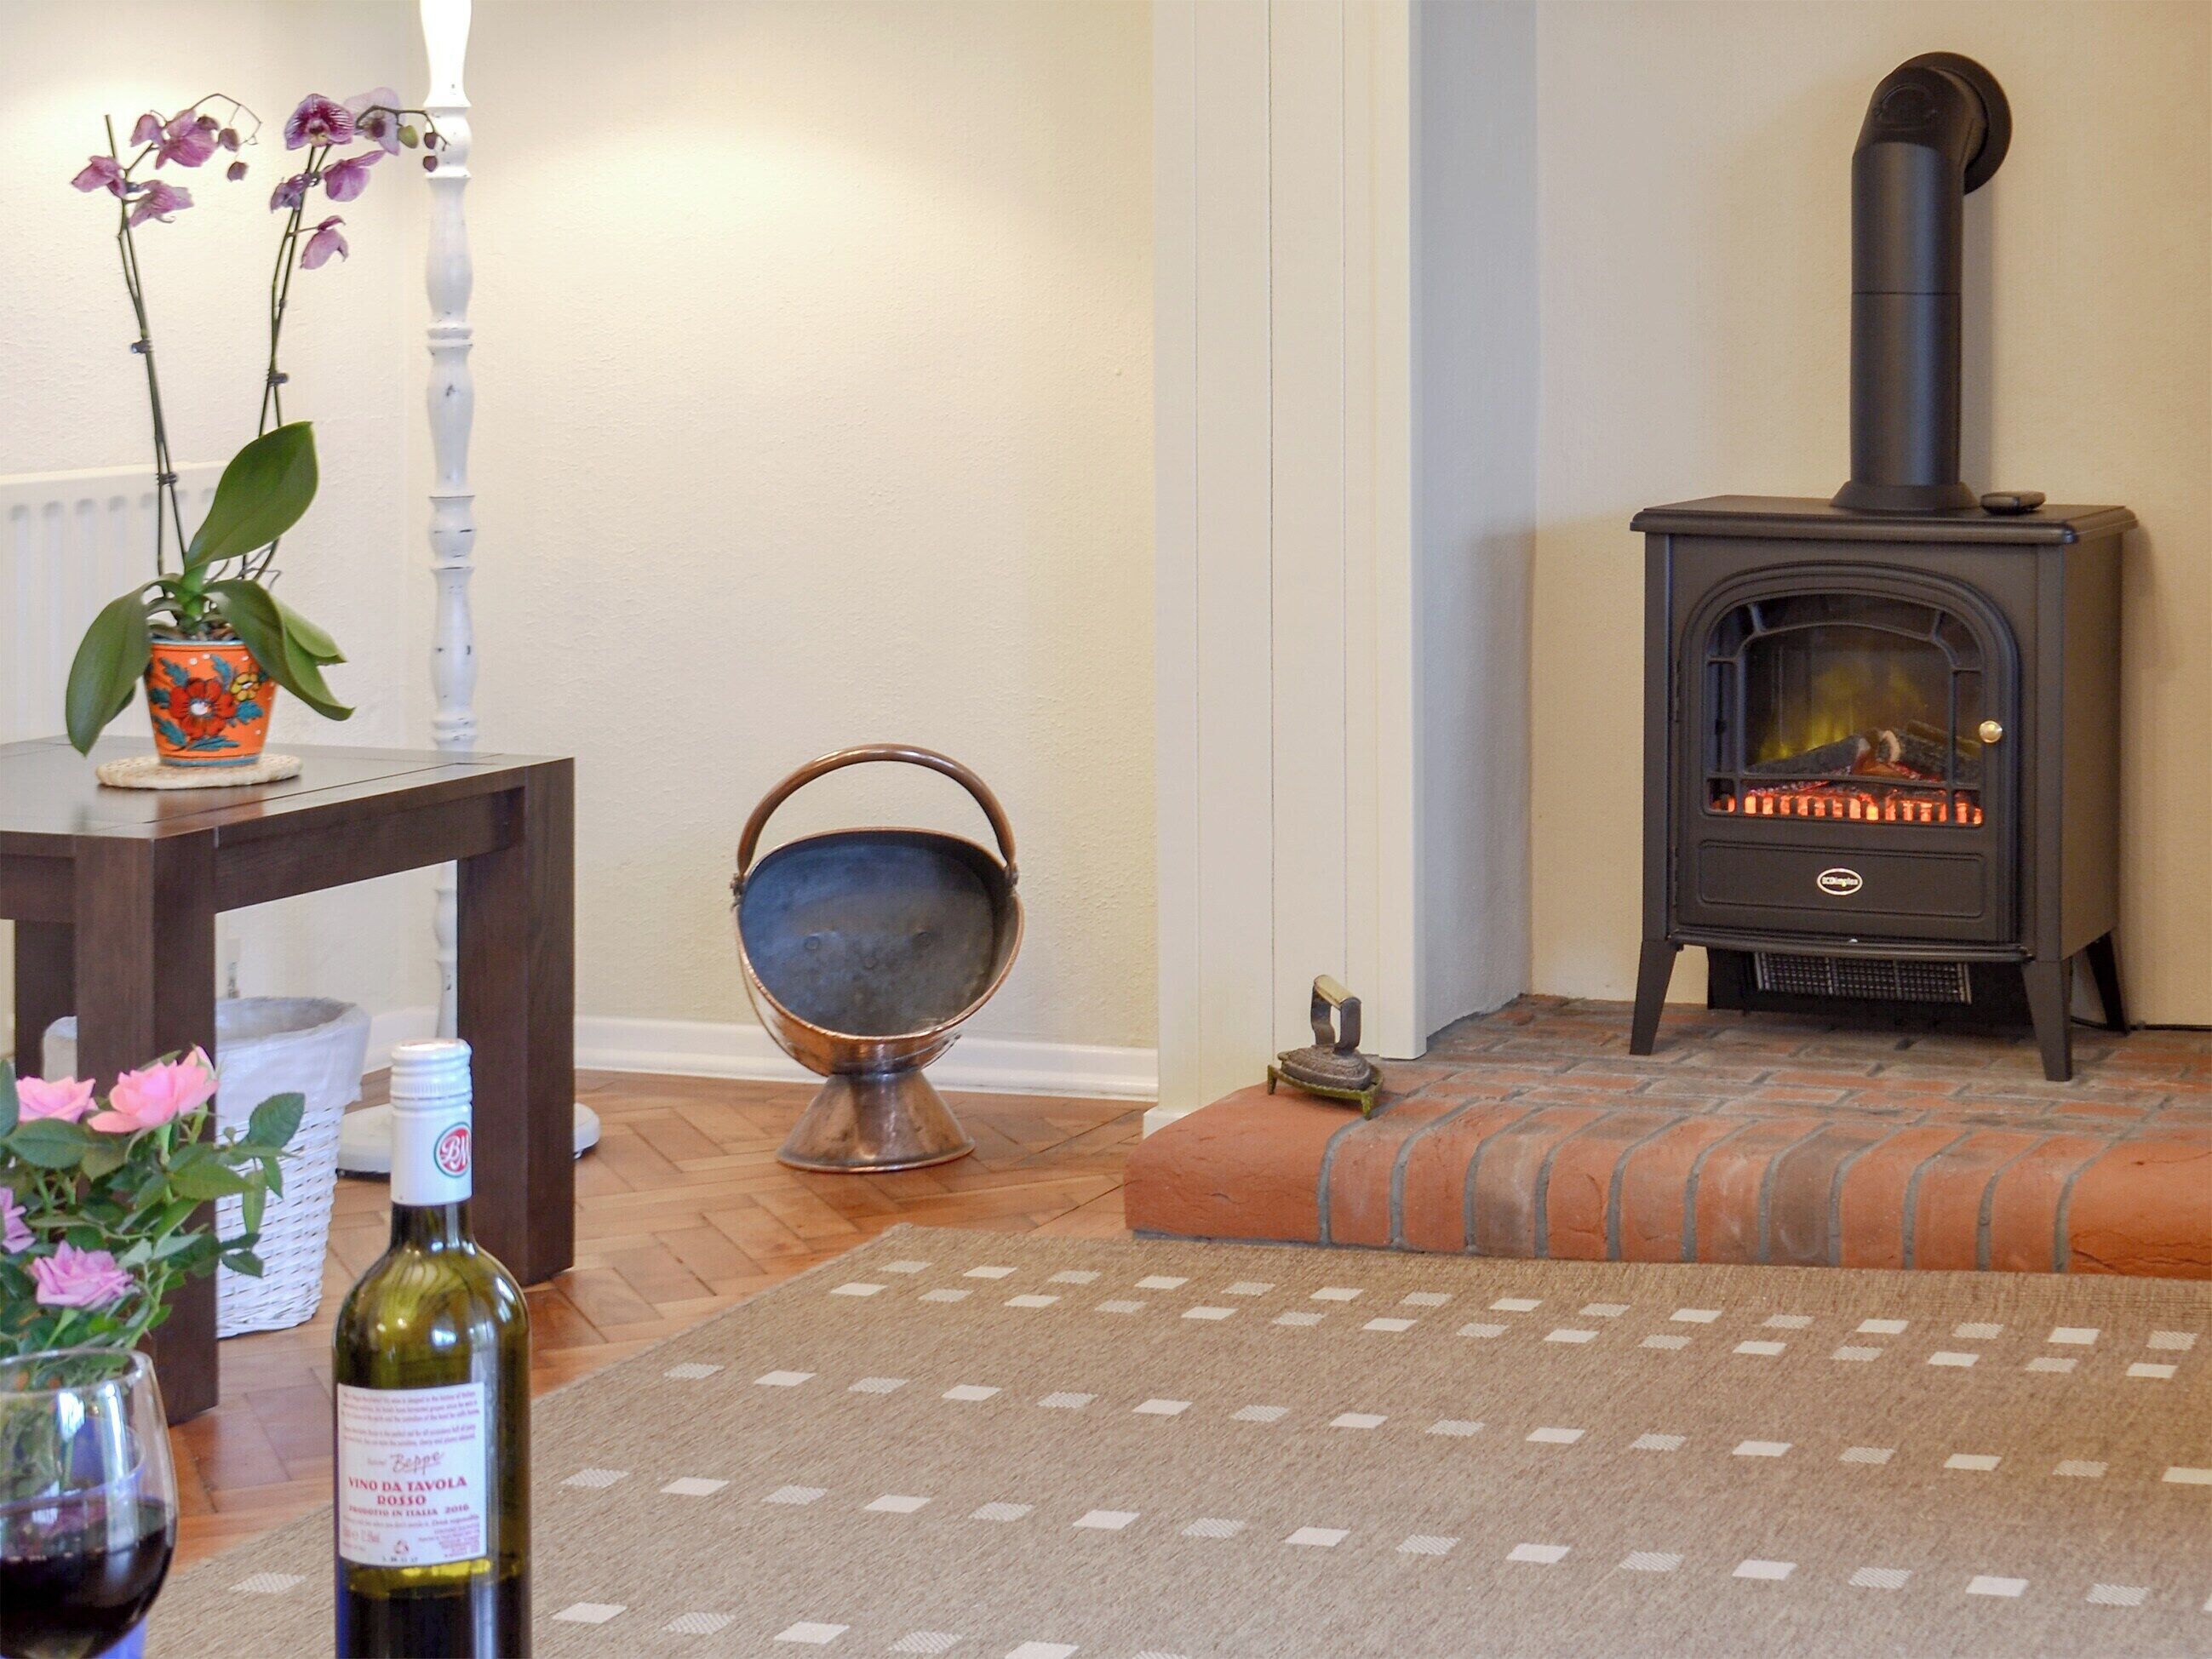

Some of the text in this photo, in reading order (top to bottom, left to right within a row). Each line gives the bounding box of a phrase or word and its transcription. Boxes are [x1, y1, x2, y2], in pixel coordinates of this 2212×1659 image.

[390, 1450, 444, 1475] Beppe
[348, 1476, 467, 1491] VINO DA TAVOLA
[377, 1495, 427, 1506] ROSSO
[349, 1506, 389, 1516] PRODOTTO
[406, 1508, 438, 1517] ITALIA
